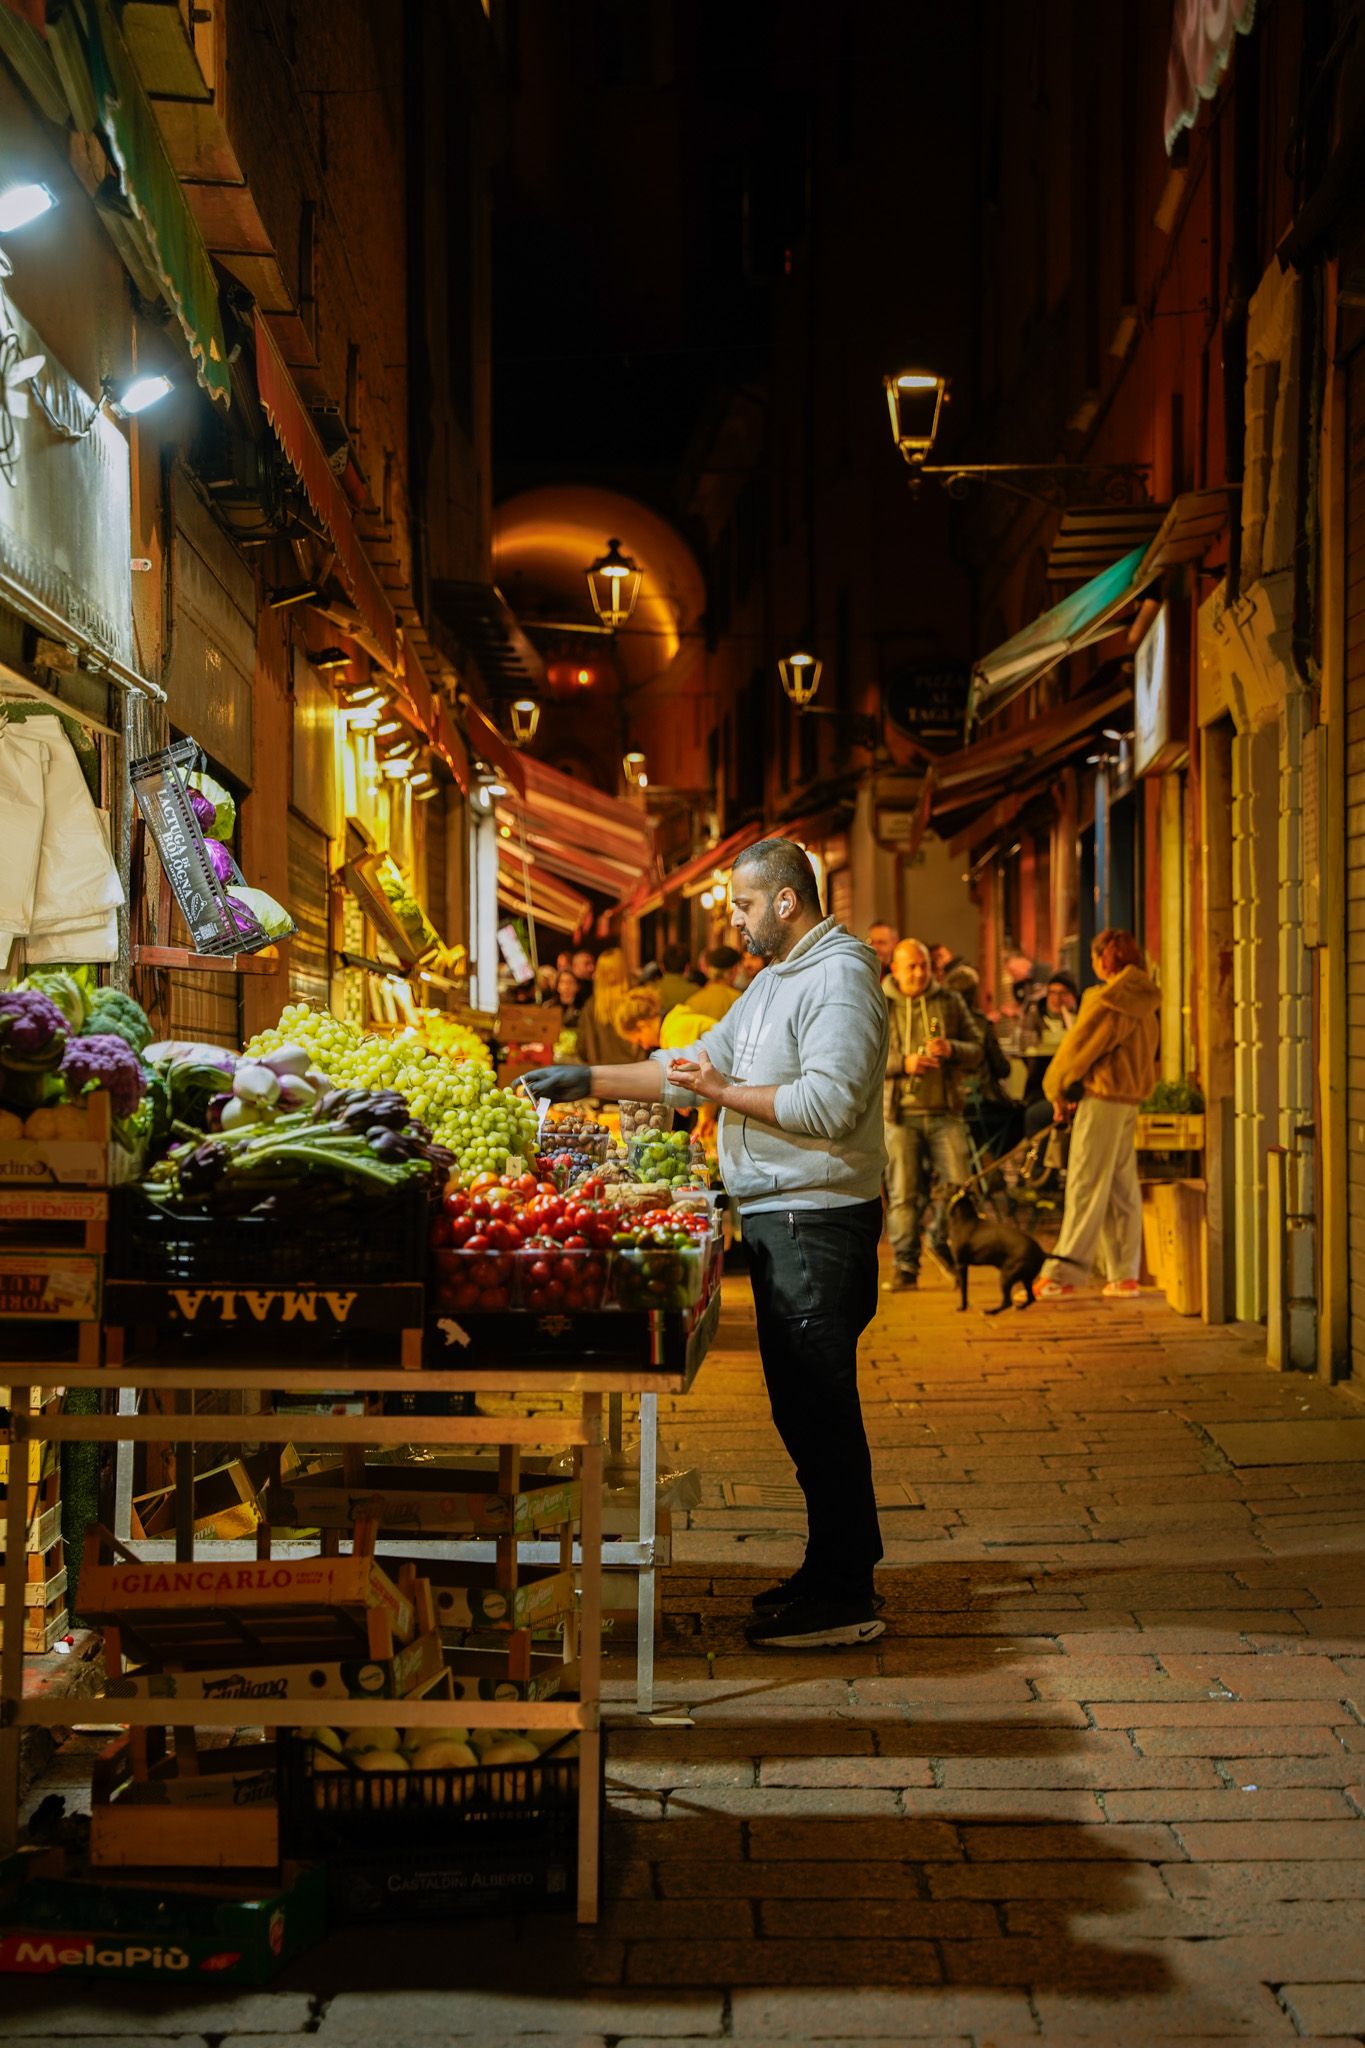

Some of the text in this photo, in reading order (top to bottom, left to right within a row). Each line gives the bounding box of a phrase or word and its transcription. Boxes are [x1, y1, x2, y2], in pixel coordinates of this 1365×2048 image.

[162, 831, 194, 899] BOLOGNA
[168, 1289, 358, 1322] AMALA
[121, 1568, 293, 1594] GIANCARLO
[387, 1873, 467, 1892] CASTALDINI
[471, 1872, 534, 1889] ALBERTO
[15, 1942, 191, 1971] MelaPiù
